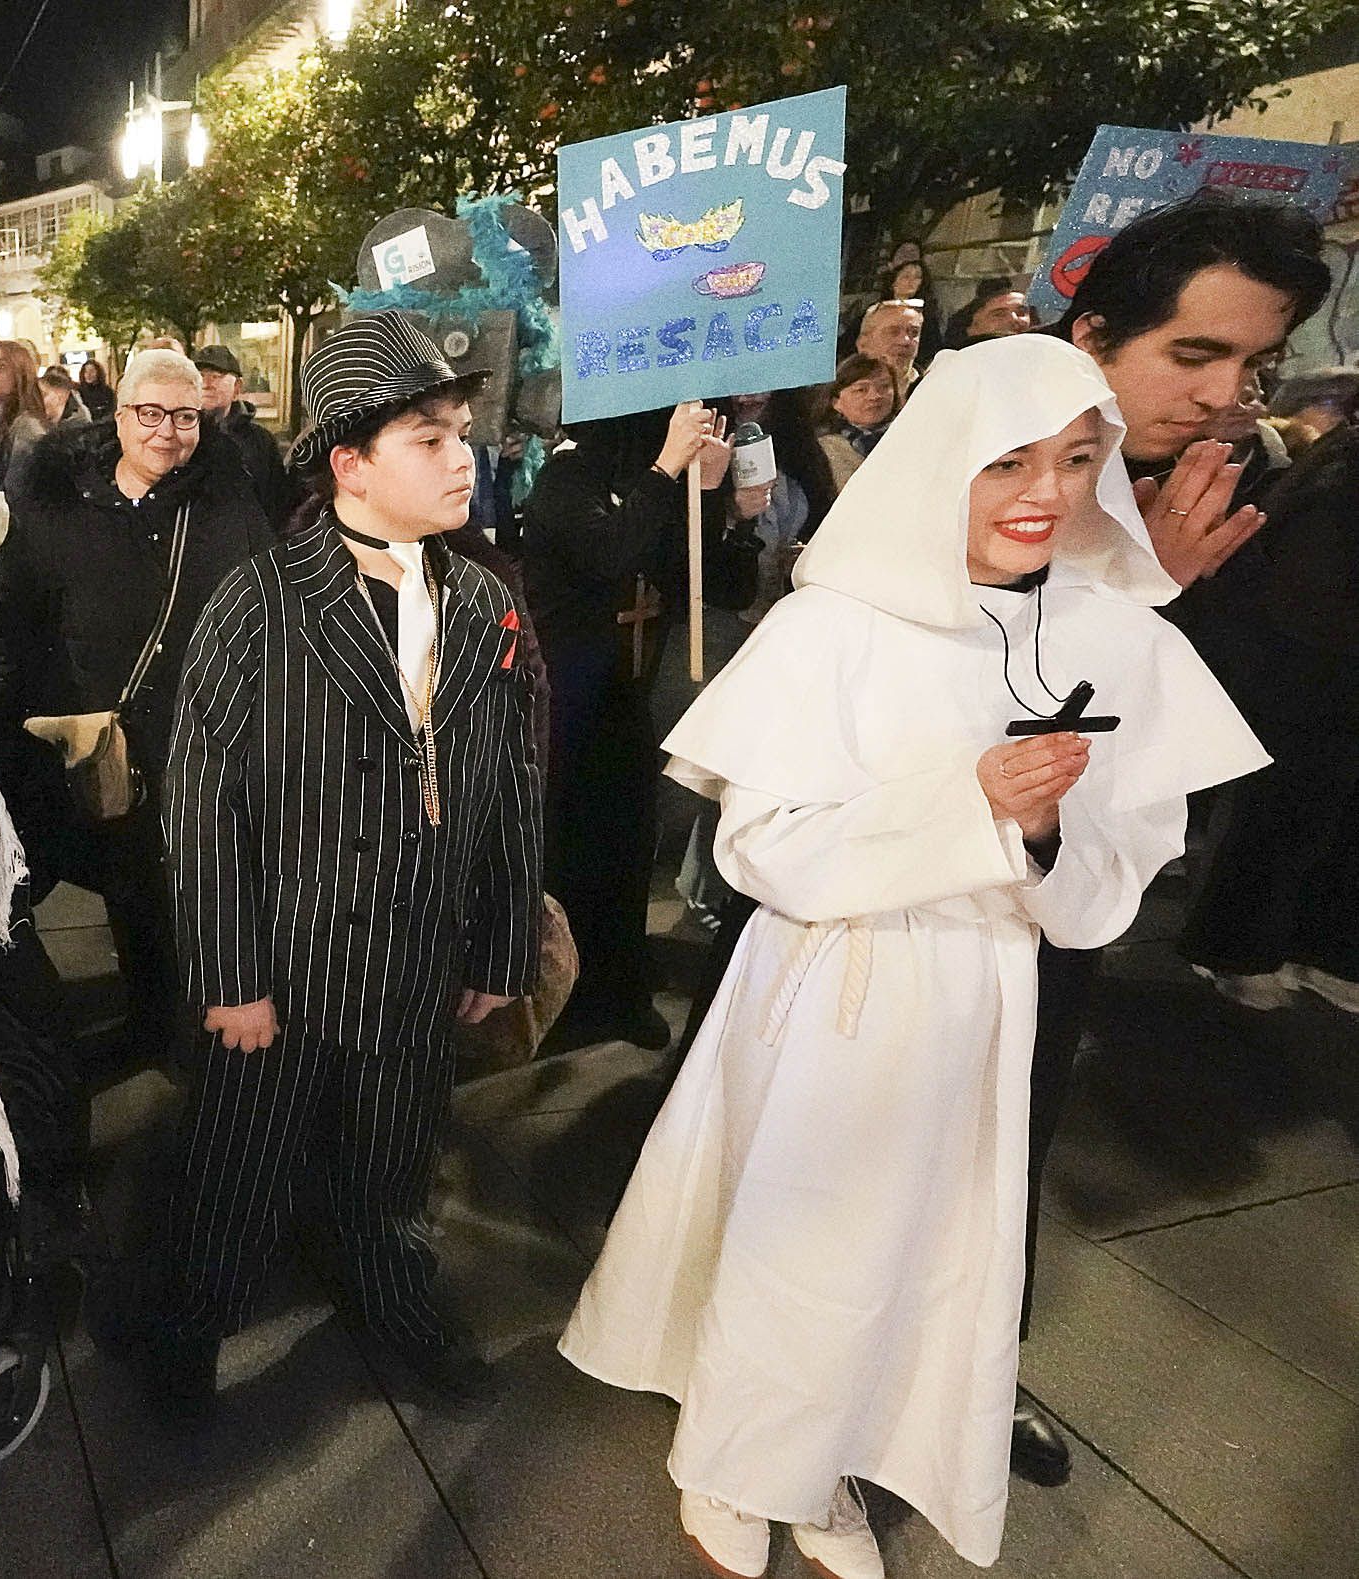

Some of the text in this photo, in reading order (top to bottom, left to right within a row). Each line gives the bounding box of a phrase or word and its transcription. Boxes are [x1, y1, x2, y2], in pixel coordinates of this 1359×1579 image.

[561, 113, 847, 253] HABEMUS
[1103, 147, 1163, 180] NO
[576, 300, 823, 379] RESACA
